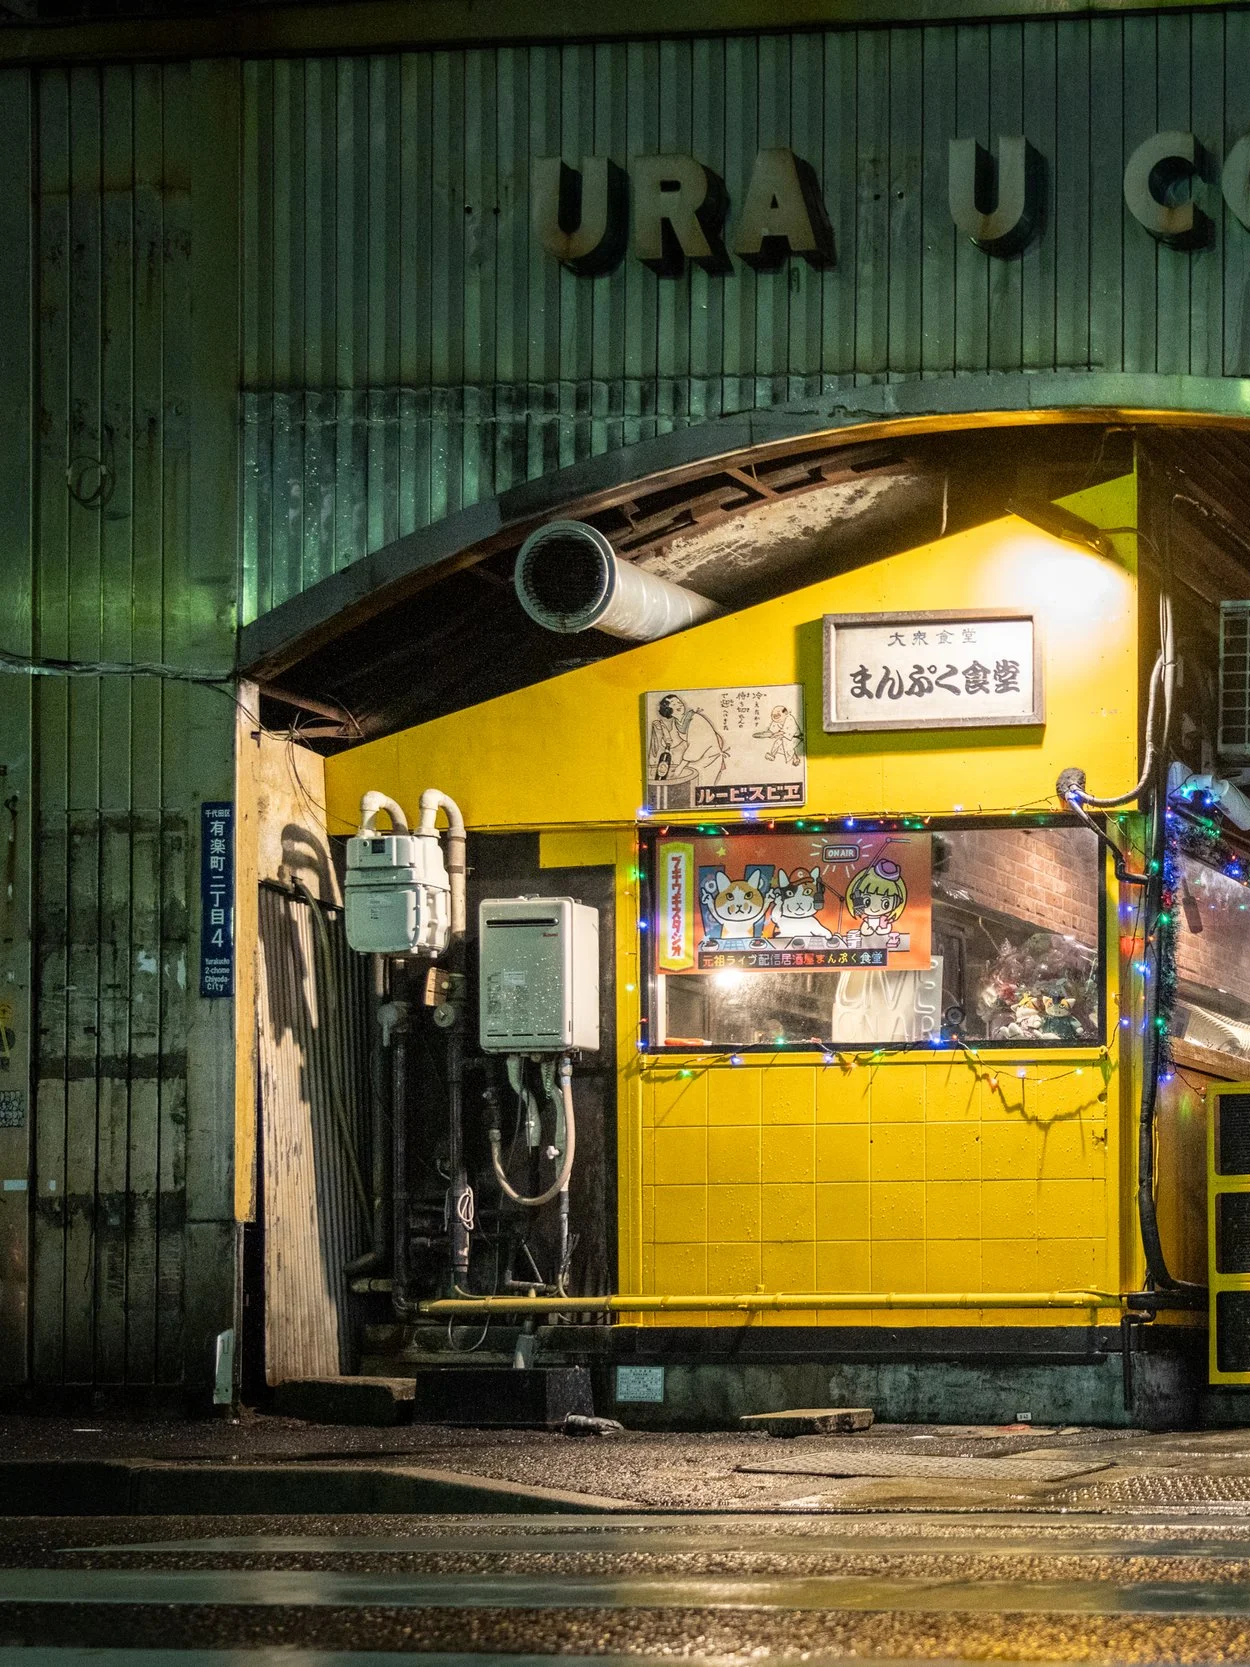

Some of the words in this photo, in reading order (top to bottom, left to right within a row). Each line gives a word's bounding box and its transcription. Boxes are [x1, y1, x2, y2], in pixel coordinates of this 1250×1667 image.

[532, 147, 836, 275] URA
[887, 628, 978, 647] 大衆食堂
[848, 658, 1022, 699] まんぷく食堂
[204, 809, 231, 818] 千代田区
[827, 850, 840, 858] ON
[840, 849, 854, 857] AIR
[702, 952, 883, 967] 元祖ライブ配信居酒屋まんぷく食堂
[204, 966, 230, 975] 2-chome
[206, 982, 224, 992] City
